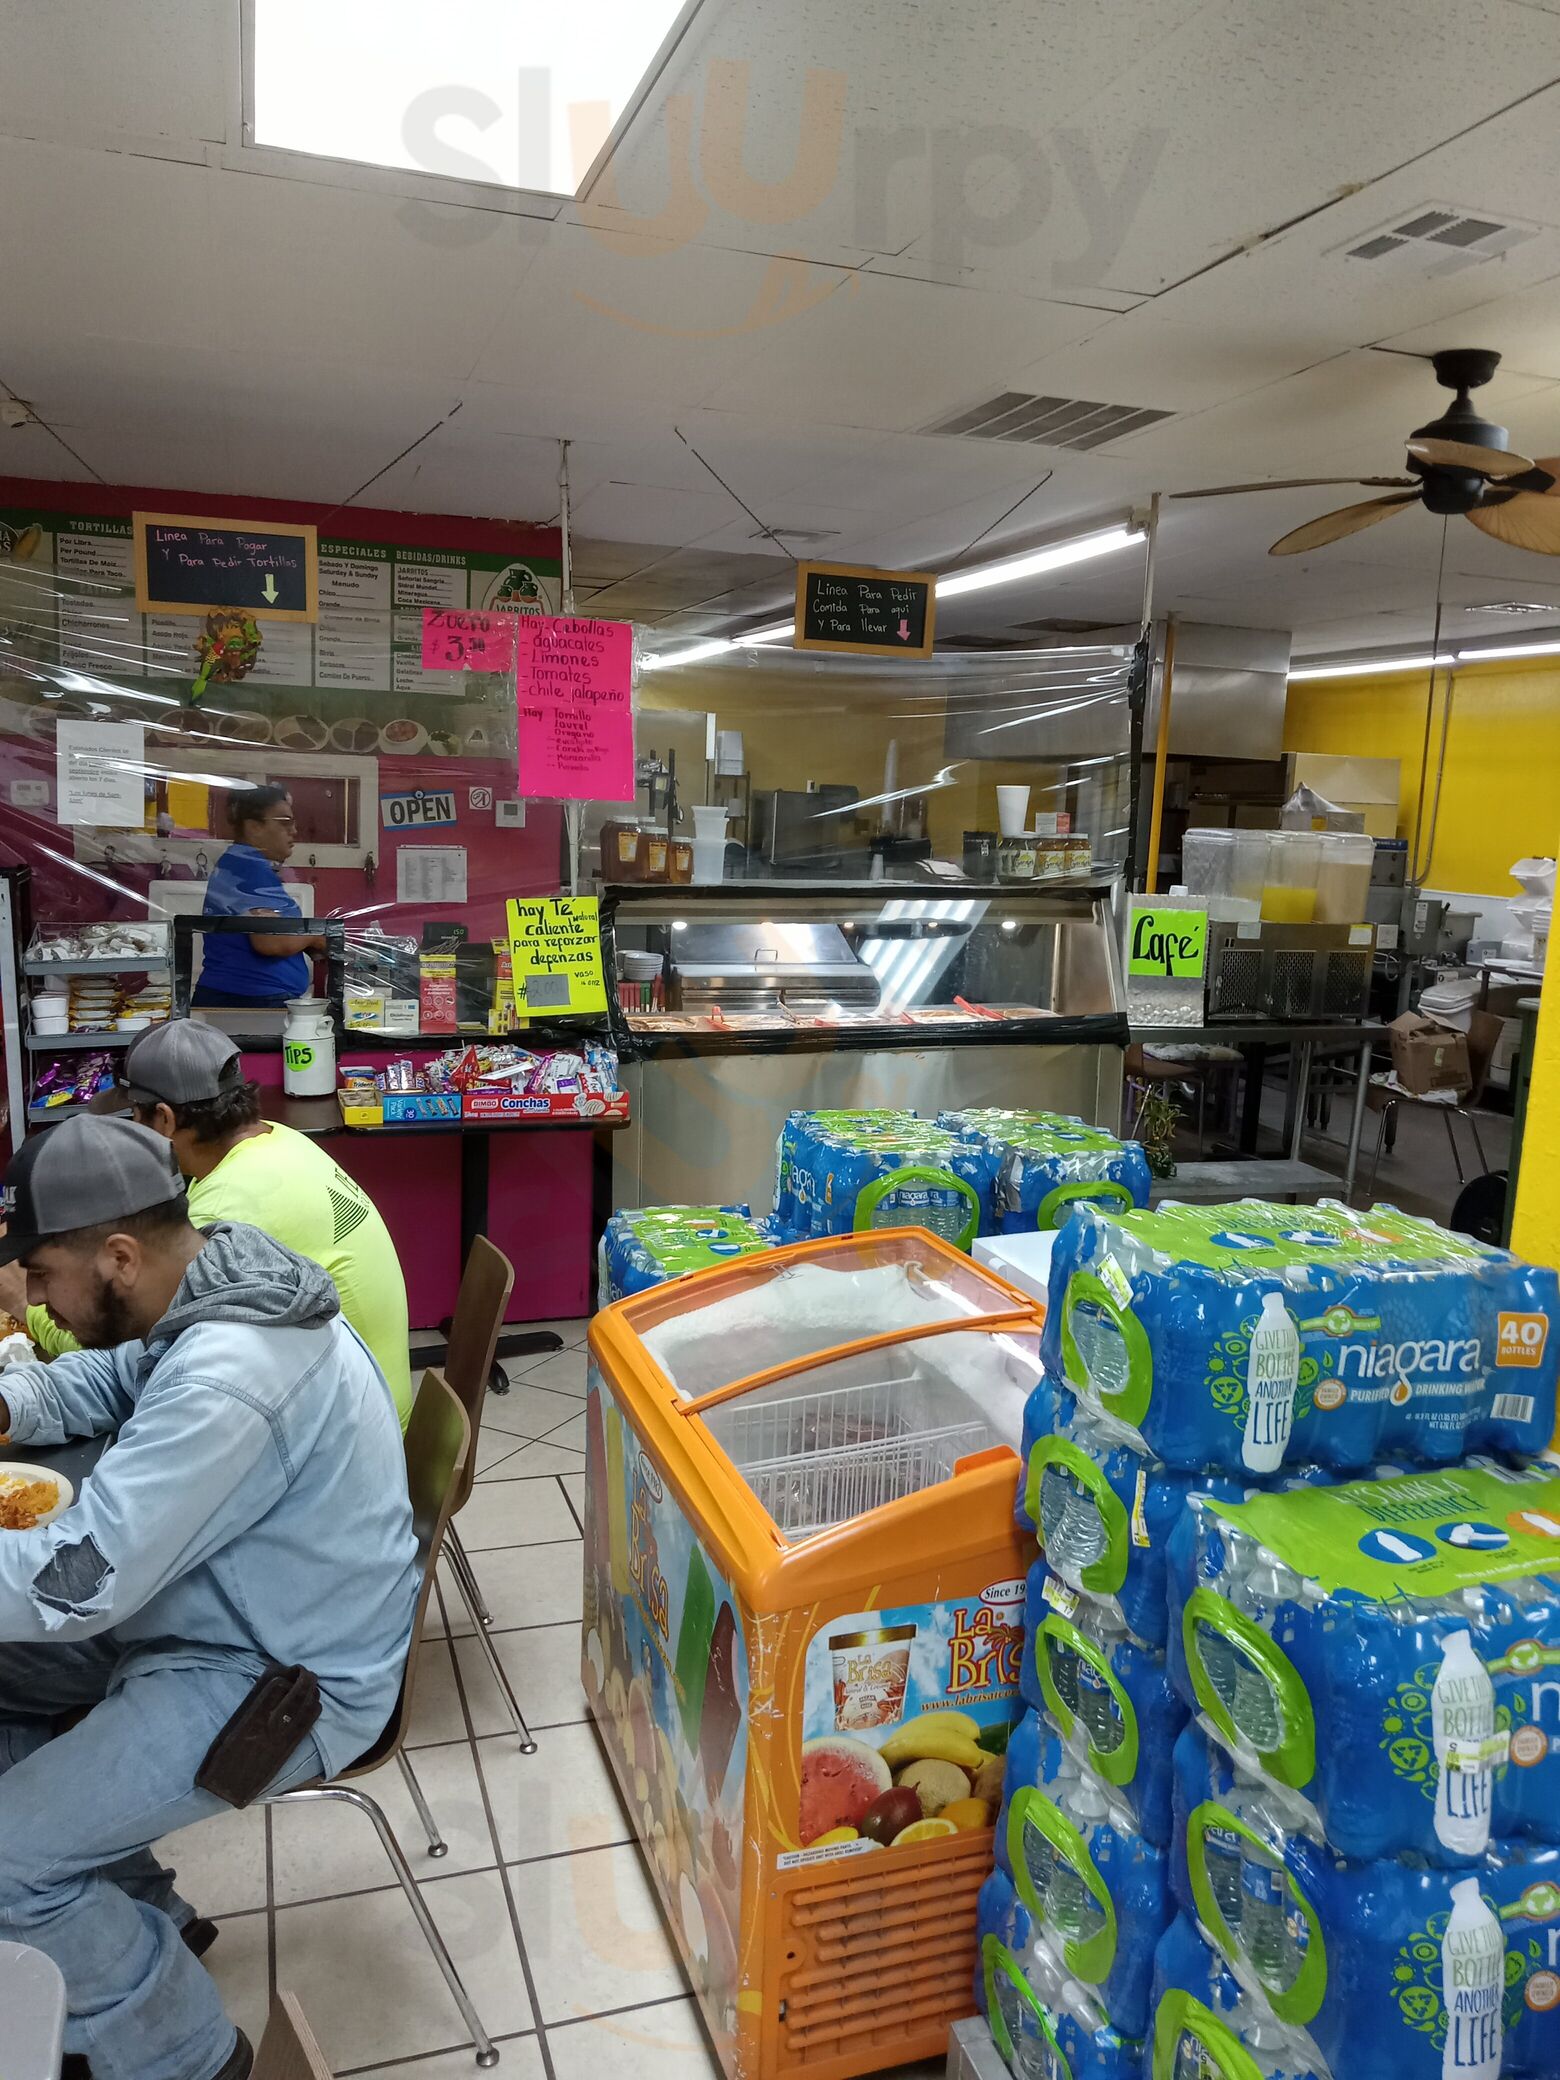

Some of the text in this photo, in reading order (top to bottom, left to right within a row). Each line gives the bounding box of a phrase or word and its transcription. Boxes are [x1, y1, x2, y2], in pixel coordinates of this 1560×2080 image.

[70, 521, 132, 535] TORTILLAS
[156, 529, 188, 542] Linea
[199, 532, 224, 545] Para
[178, 553, 204, 566] Para
[213, 555, 242, 568] Pedir
[246, 555, 297, 568] Tortillas
[321, 544, 387, 558] ESPECIALES
[396, 550, 466, 565] BEBIDAS/DRINKS
[319, 560, 343, 568] Sabado
[351, 563, 378, 572] Domingo
[319, 568, 347, 577] Saturday
[355, 572, 378, 580] Sunday
[398, 567, 428, 576] JARRITOS
[332, 580, 359, 588] Menudo
[817, 580, 917, 602] Linea Para Pedir
[813, 599, 909, 619] Comida Para aqui
[553, 618, 614, 637] Cebollas
[830, 619, 851, 632] Para
[861, 618, 887, 633] llevar
[532, 649, 599, 667] Limones
[532, 666, 591, 684] Tomates
[390, 796, 452, 824] OPEN
[516, 898, 576, 925] hay Té
[513, 935, 598, 954] para reforzar
[530, 948, 593, 973] defenzas
[574, 970, 593, 978] vaso
[285, 1045, 312, 1064] TIPS
[501, 1097, 549, 1109] Conchas
[1255, 1329, 1281, 1351] GIVE
[1500, 1321, 1542, 1346] 40
[1501, 1346, 1536, 1356] BOTTLES
[1338, 1338, 1481, 1391] niagara
[1350, 1387, 1390, 1401] PURIFIED
[1416, 1382, 1463, 1396] DRINKING
[1253, 1400, 1290, 1445] LIFE
[984, 1583, 1027, 1600] Since 19
[953, 1607, 994, 1639] La
[847, 1660, 892, 1683] Brisa
[945, 1636, 1025, 1694] Bris
[1438, 1676, 1470, 1704] GIVE
[1446, 1767, 1489, 1819] LIFE
[1450, 1928, 1480, 1956] GIVE
[1454, 1983, 1500, 2013] ANOTHER
[1454, 2009, 1498, 2067] LIFE
